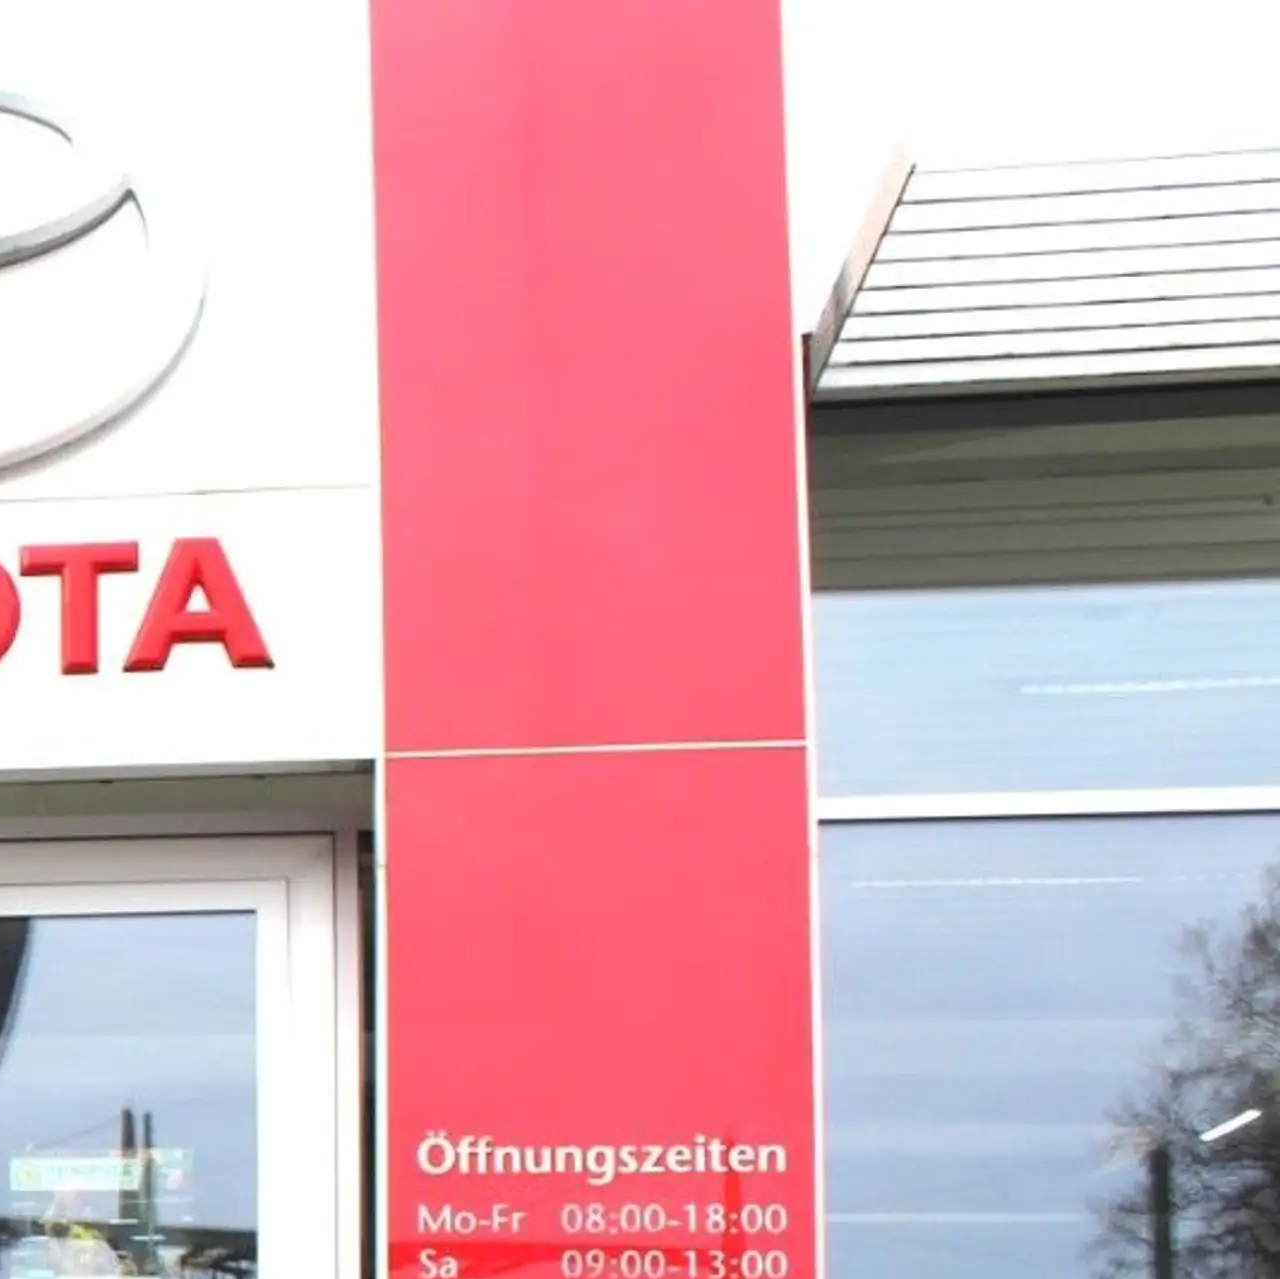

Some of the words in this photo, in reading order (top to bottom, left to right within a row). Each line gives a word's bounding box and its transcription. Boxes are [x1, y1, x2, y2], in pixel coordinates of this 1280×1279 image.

[416, 1130, 787, 1187] Öffnungszeiten
[417, 1203, 526, 1234] Mo-Fr
[560, 1203, 788, 1234] 08:00-18:00
[419, 1248, 458, 1279] Sa
[561, 1248, 789, 1279] 09:00-13:00
